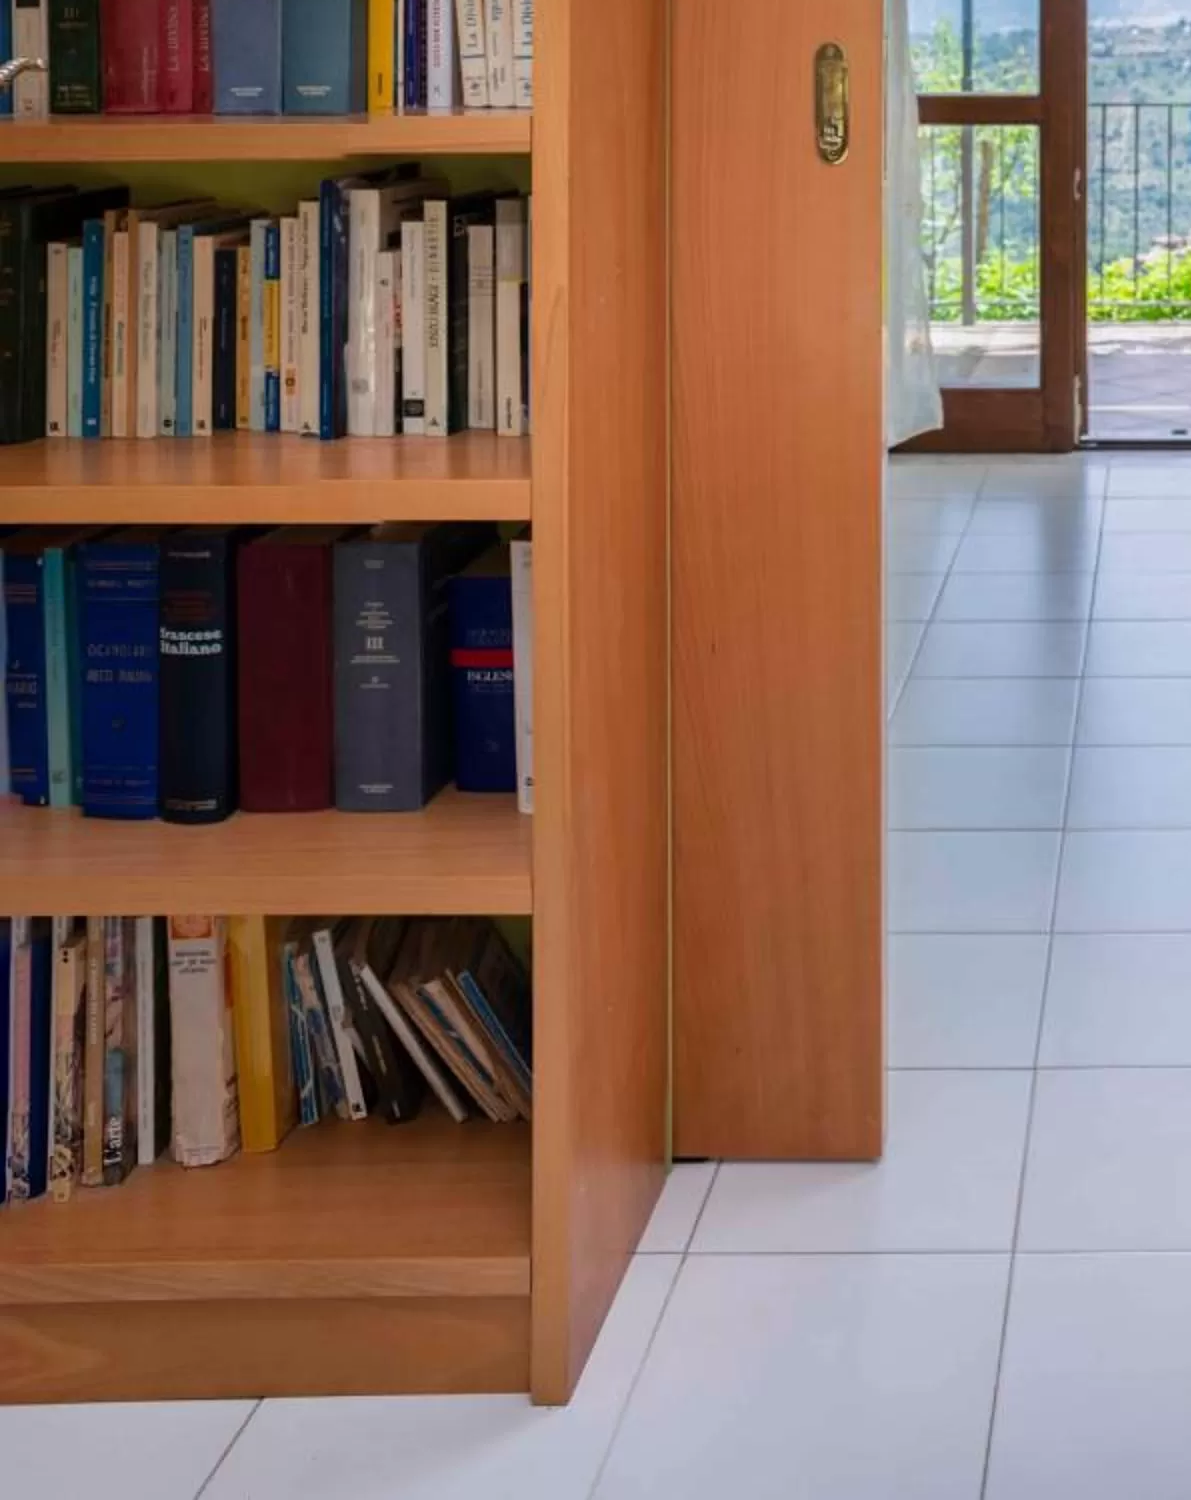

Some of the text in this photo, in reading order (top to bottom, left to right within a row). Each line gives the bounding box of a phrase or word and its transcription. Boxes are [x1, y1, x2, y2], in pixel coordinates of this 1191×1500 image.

[160, 627, 223, 642] francese
[160, 640, 222, 656] italiano
[103, 1116, 122, 1166] L'arte
